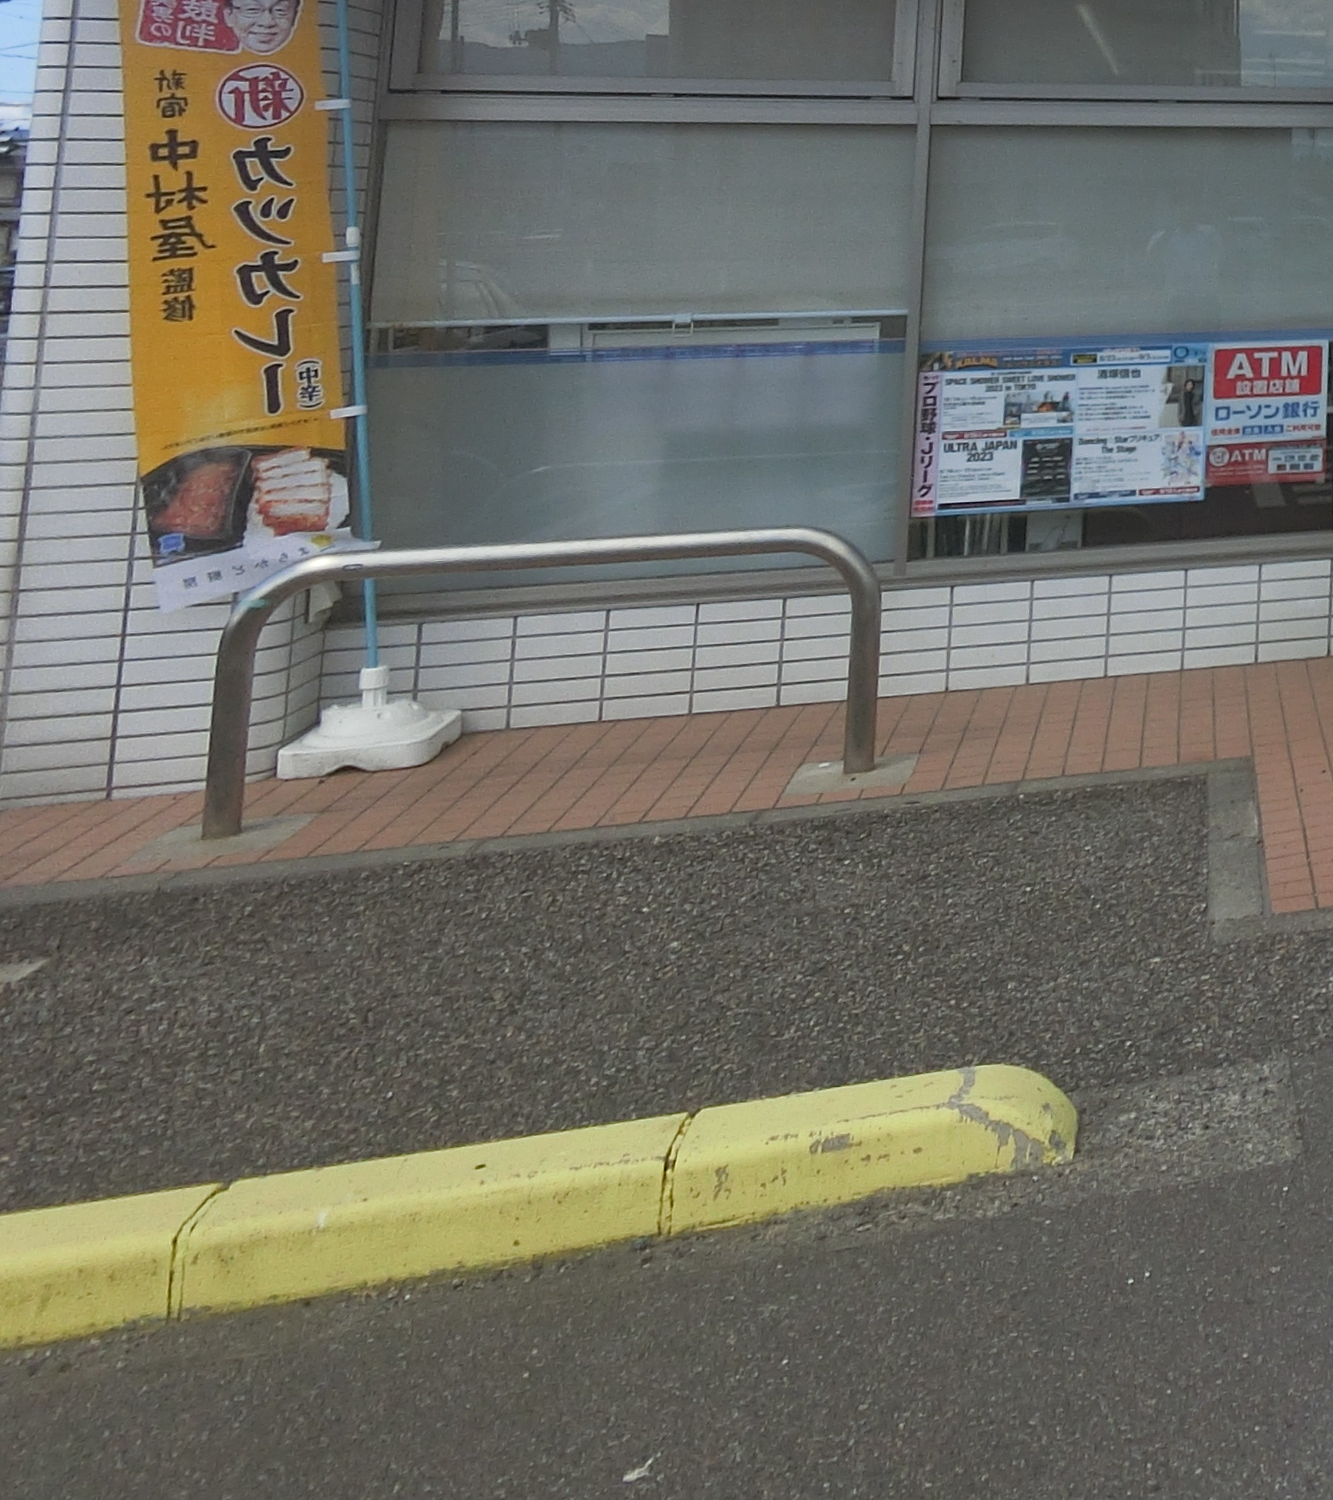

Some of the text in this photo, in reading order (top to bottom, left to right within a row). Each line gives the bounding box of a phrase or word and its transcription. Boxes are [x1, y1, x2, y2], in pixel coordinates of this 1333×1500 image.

[1226, 350, 1308, 380] ATM
[1214, 401, 1320, 421] ローソン銀行
[943, 440, 1018, 453] ULTRA JAPAN
[966, 452, 994, 462] 2023
[1230, 448, 1266, 463] ATM
